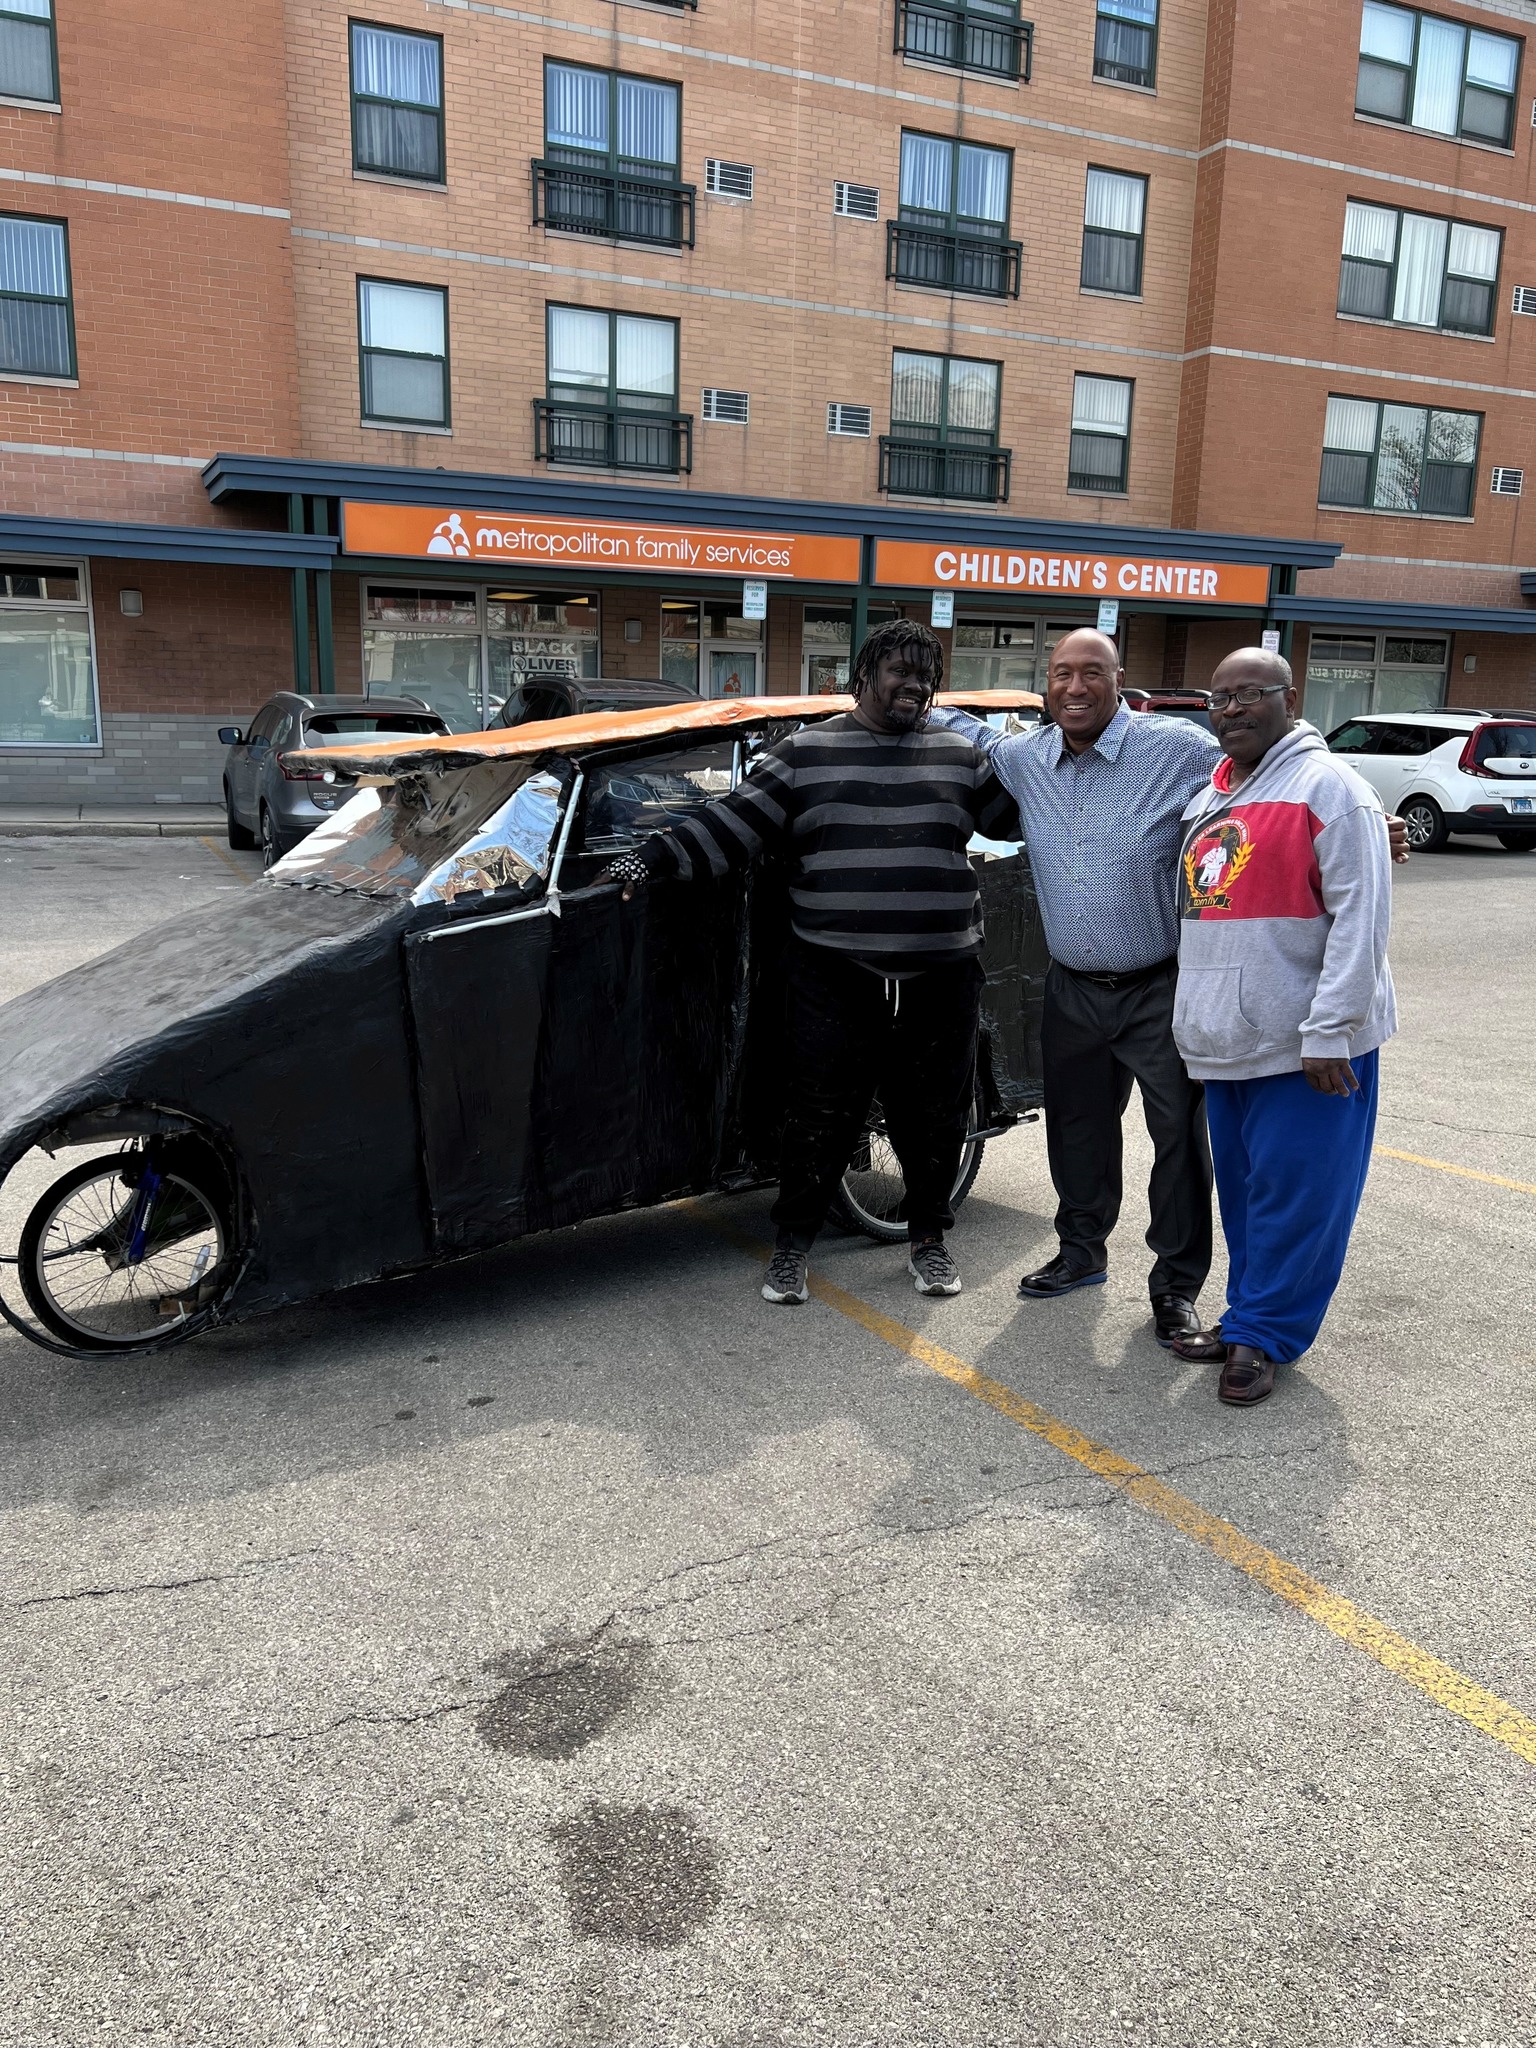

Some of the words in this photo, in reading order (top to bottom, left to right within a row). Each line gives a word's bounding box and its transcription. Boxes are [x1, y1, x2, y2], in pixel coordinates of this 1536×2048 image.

[476, 527, 630, 557] metropolitan
[635, 535, 701, 566] family
[706, 543, 790, 567] services
[934, 551, 1108, 589] CHILDREN'S
[1118, 563, 1218, 596] CENTER
[816, 620, 846, 634] 3215
[512, 640, 575, 655] BLACK
[528, 658, 575, 671] LIVES
